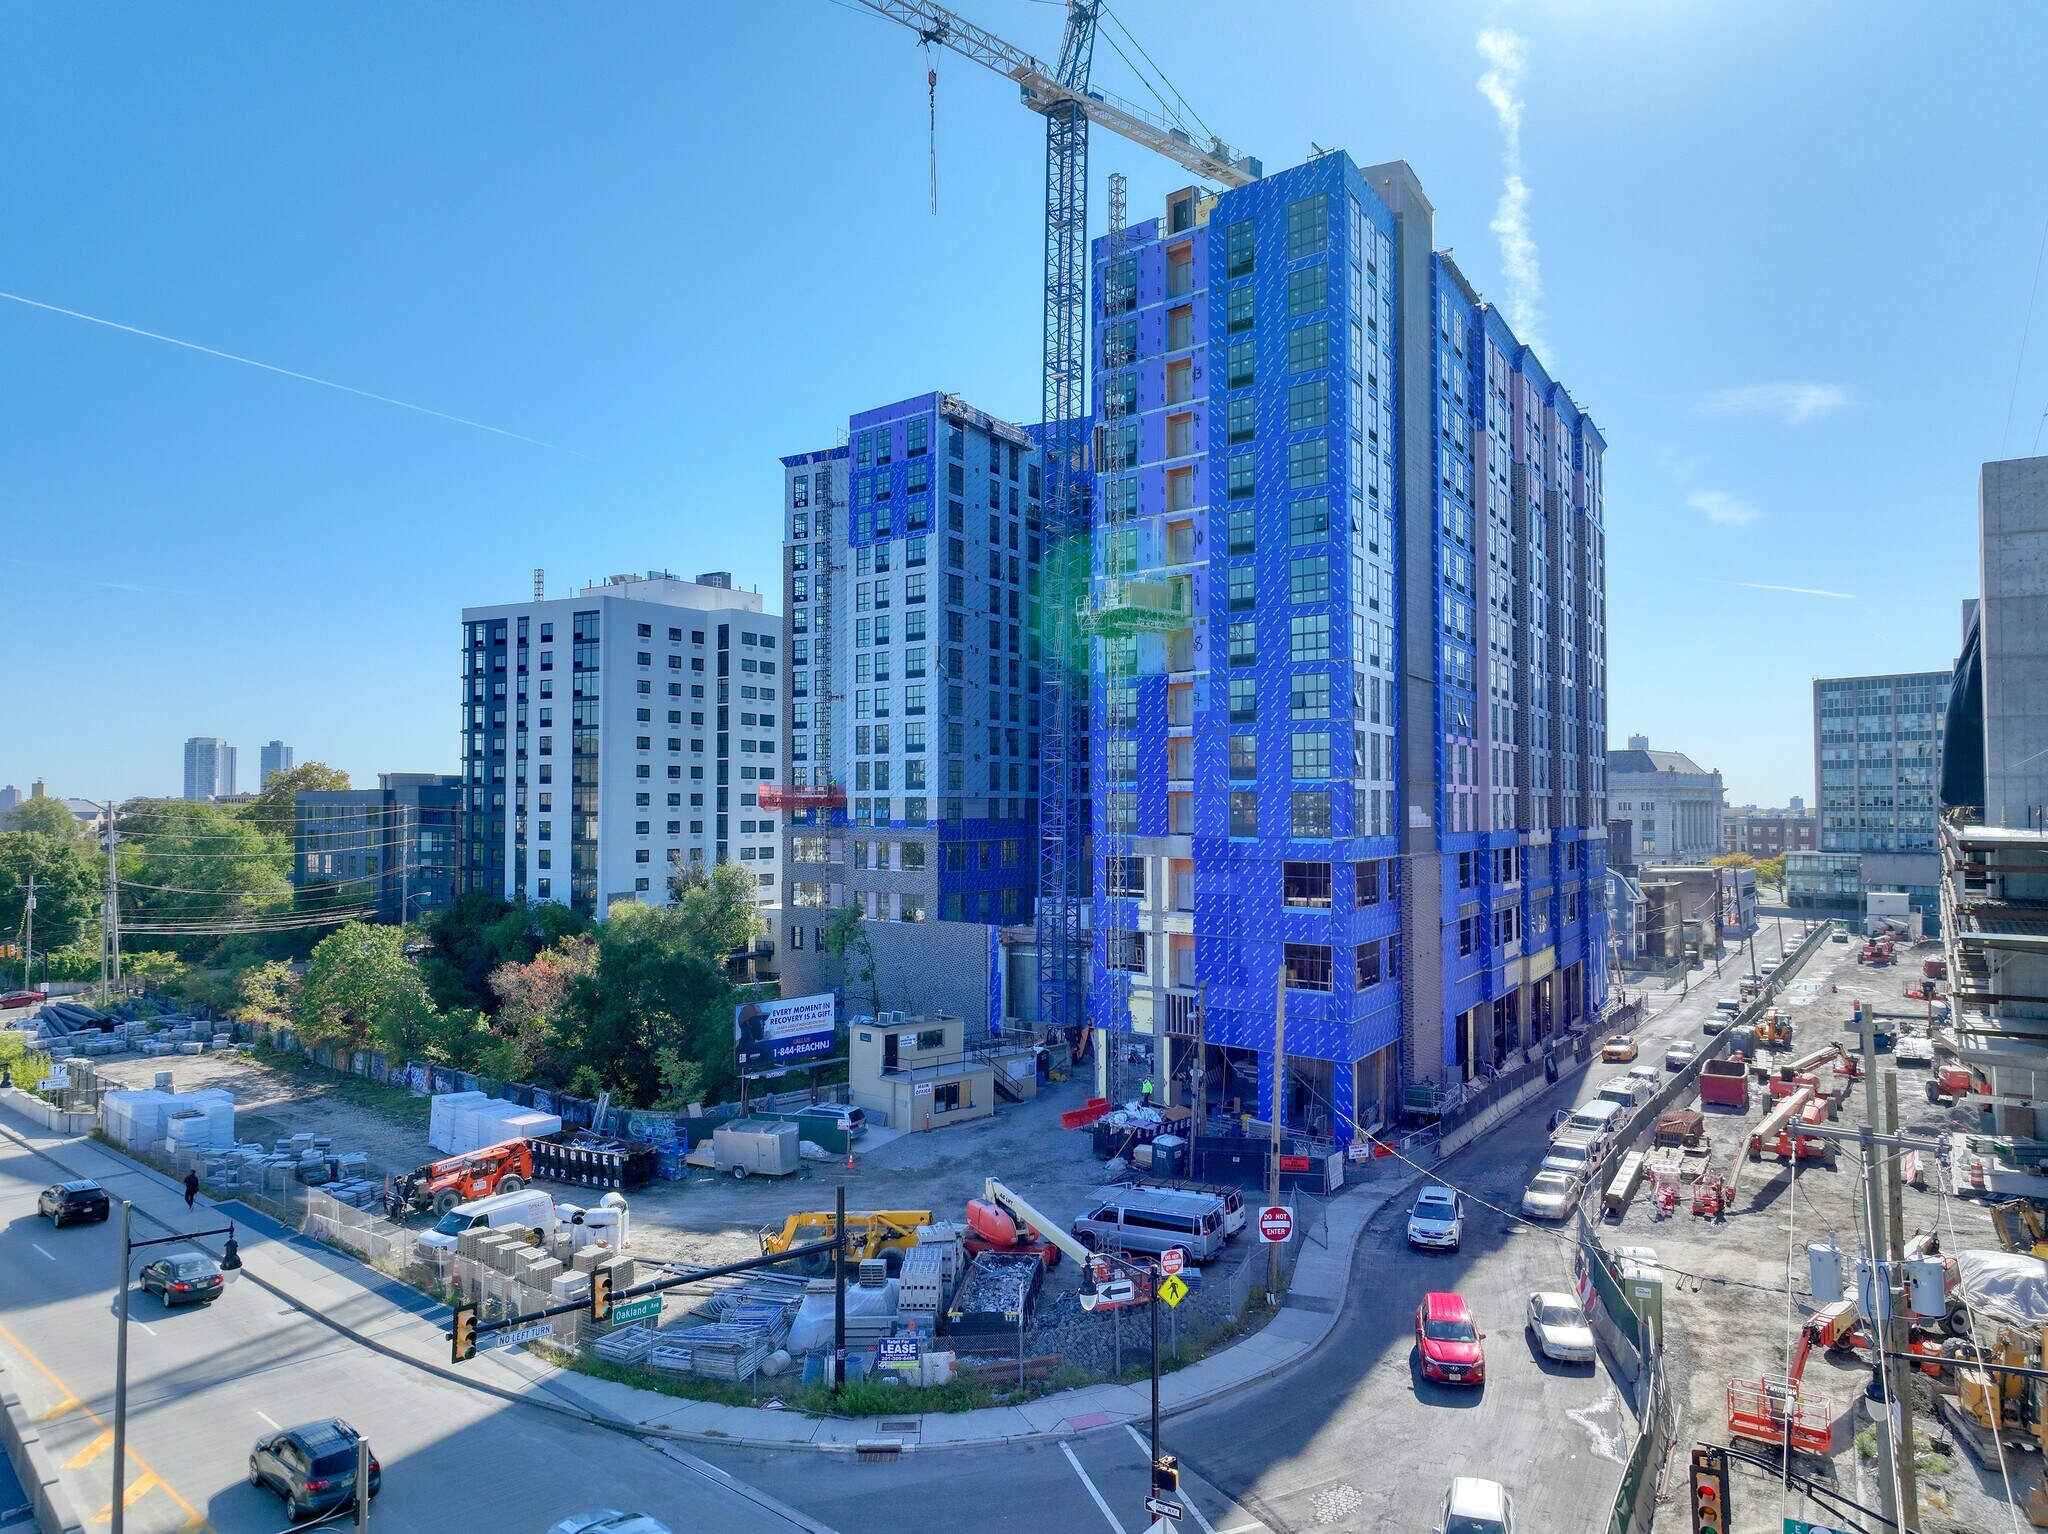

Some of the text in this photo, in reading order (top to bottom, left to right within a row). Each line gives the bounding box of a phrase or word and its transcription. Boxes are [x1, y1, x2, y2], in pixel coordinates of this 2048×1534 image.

[1195, 635, 1203, 651] 8
[772, 1002, 831, 1017] EVERY MOMENT IN
[770, 1015, 802, 1025] RECOVERY
[773, 1040, 830, 1058] 1-844-REACHNJ
[531, 1141, 620, 1167] EVERGREEN
[616, 1304, 647, 1321] Oakland
[499, 1325, 551, 1345] NO LEFT TURN
[880, 1343, 916, 1354] LEASE
